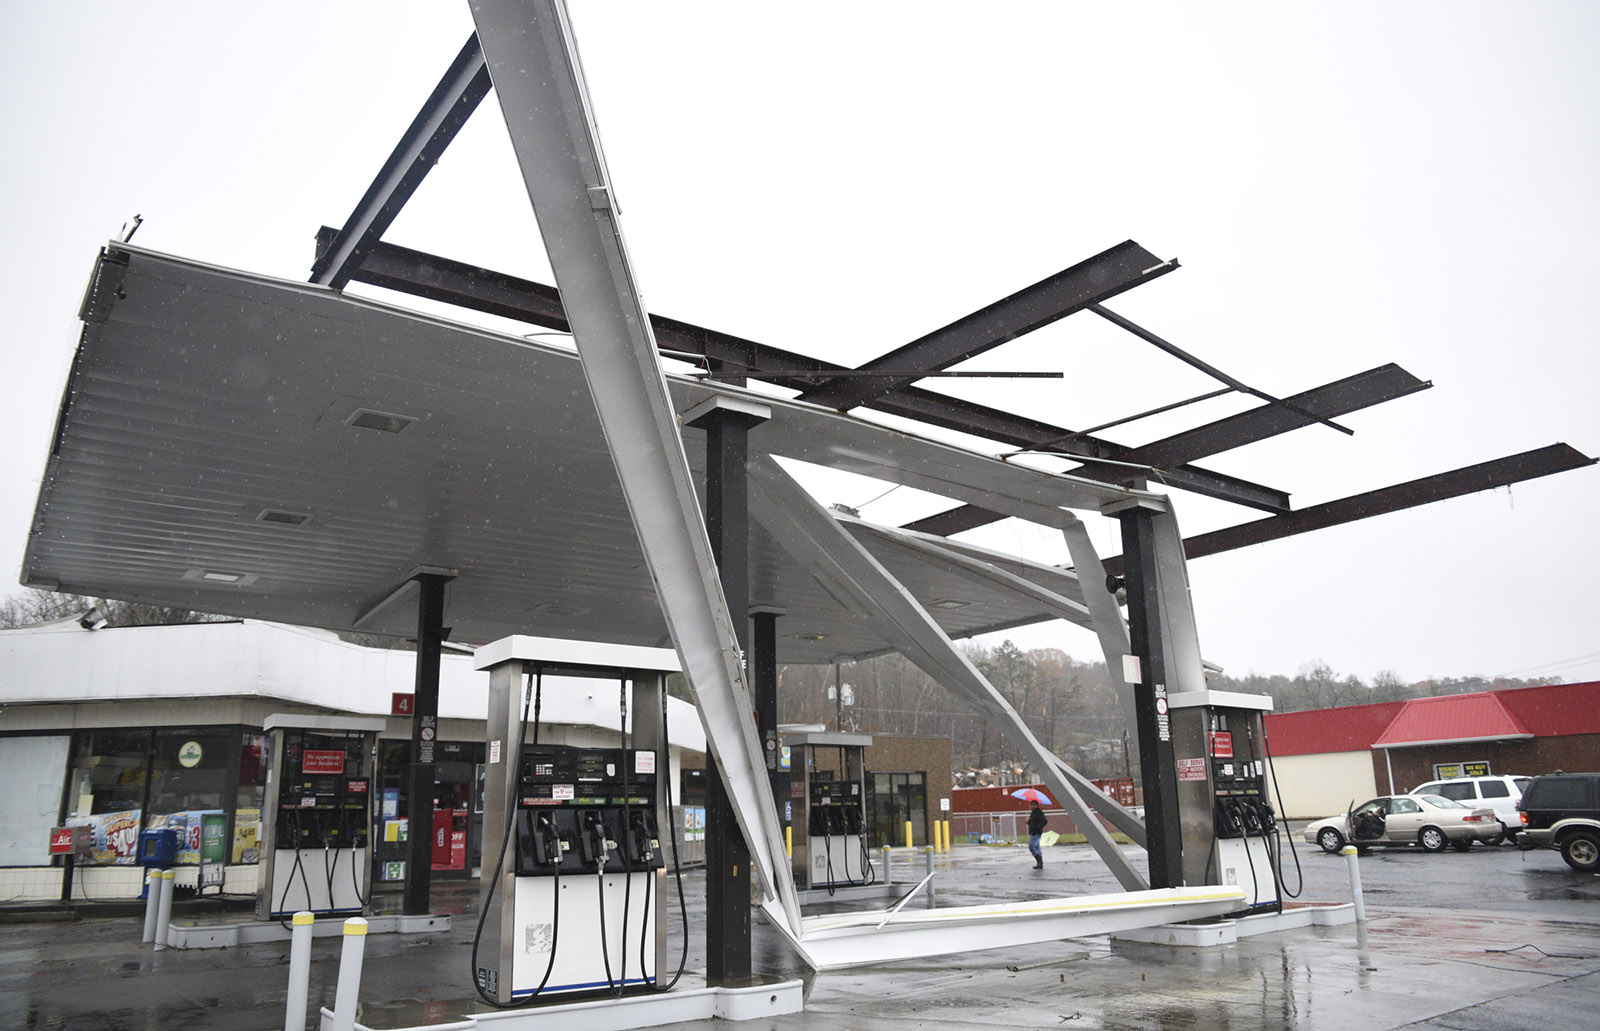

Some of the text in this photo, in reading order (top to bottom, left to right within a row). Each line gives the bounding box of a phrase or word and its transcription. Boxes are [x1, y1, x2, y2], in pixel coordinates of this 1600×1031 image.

[398, 698, 409, 712] 4
[1190, 758, 1204, 766] SERVE
[58, 834, 71, 843] Air
